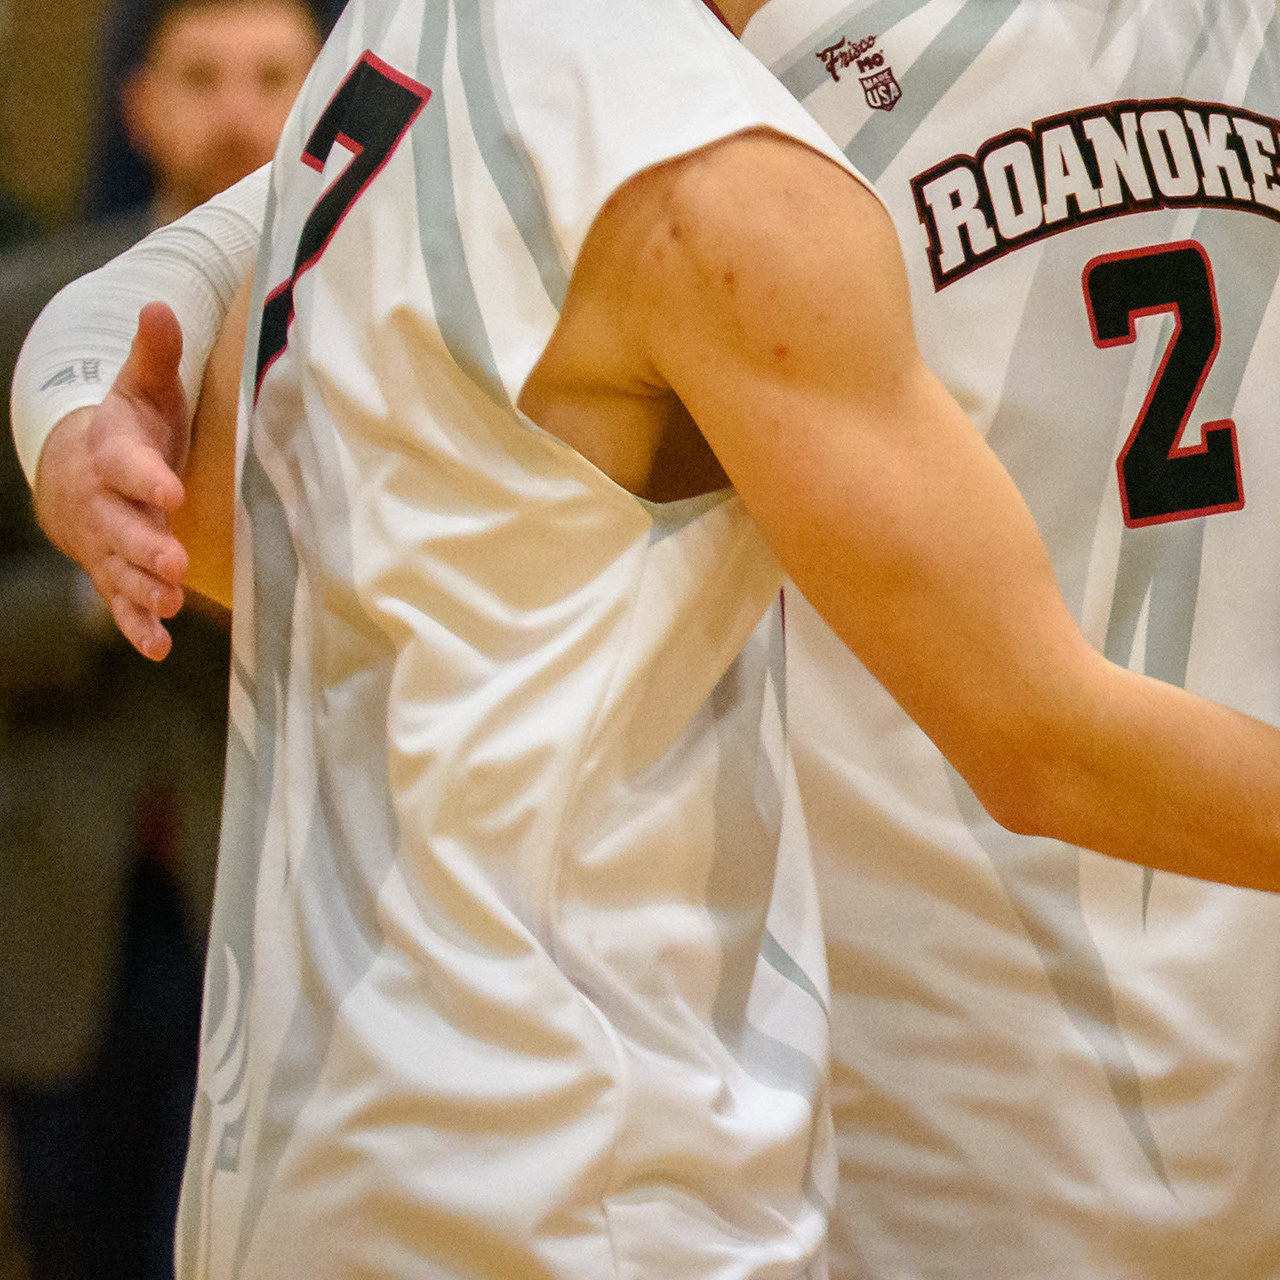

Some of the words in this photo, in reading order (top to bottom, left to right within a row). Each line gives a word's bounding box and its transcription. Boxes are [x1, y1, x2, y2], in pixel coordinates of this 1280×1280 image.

[815, 35, 878, 82] Frisco
[863, 71, 892, 90] MADE
[866, 82, 899, 107] USA
[253, 49, 432, 413] 7
[1082, 239, 1245, 529] 2
